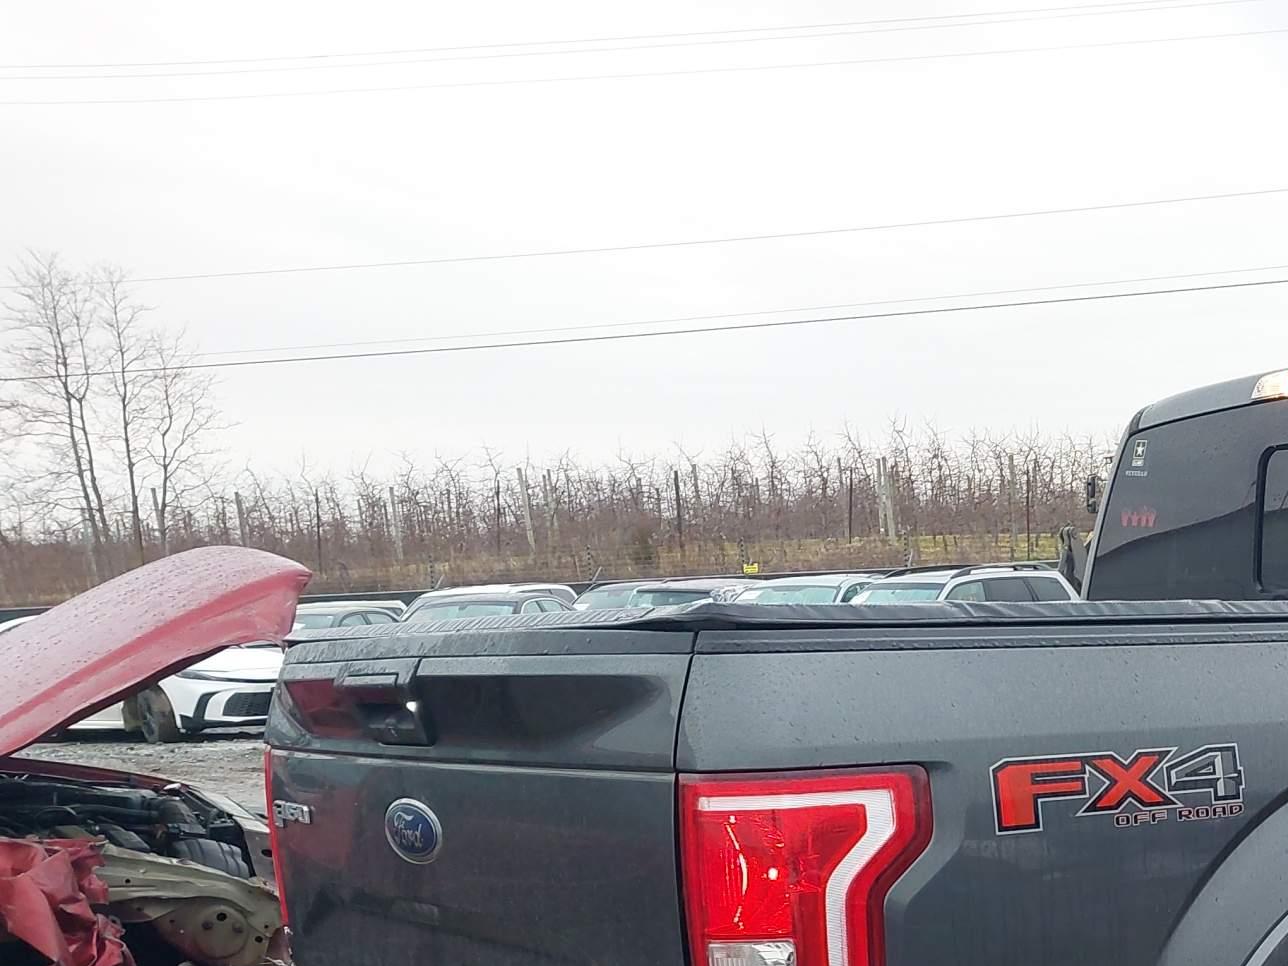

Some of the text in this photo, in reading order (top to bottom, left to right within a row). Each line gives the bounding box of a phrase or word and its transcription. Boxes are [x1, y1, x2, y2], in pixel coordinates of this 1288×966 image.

[989, 743, 1245, 835] FX4
[393, 811, 424, 848] Ford
[1114, 803, 1245, 828] OFF ROAD
